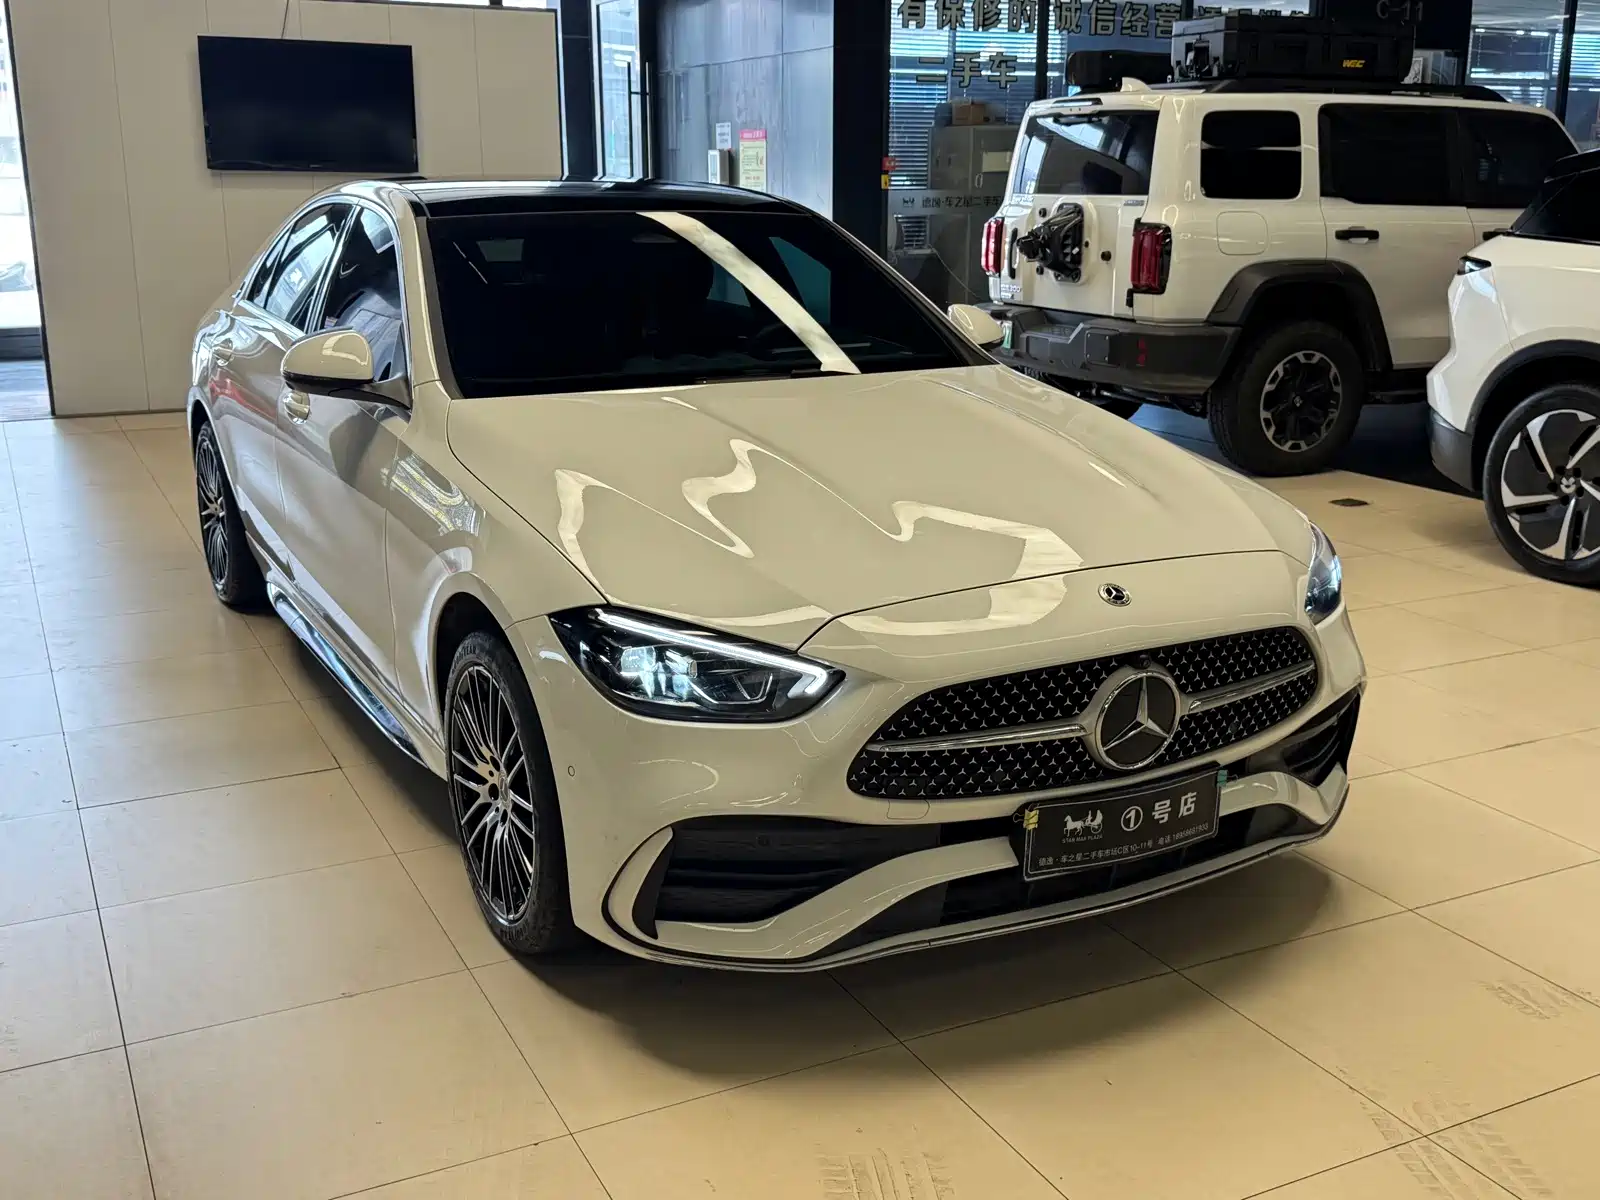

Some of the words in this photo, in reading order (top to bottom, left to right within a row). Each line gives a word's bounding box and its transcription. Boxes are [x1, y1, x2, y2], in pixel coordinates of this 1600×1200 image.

[1376, 0, 1424, 21] C-11
[916, 51, 1018, 89] 二手车
